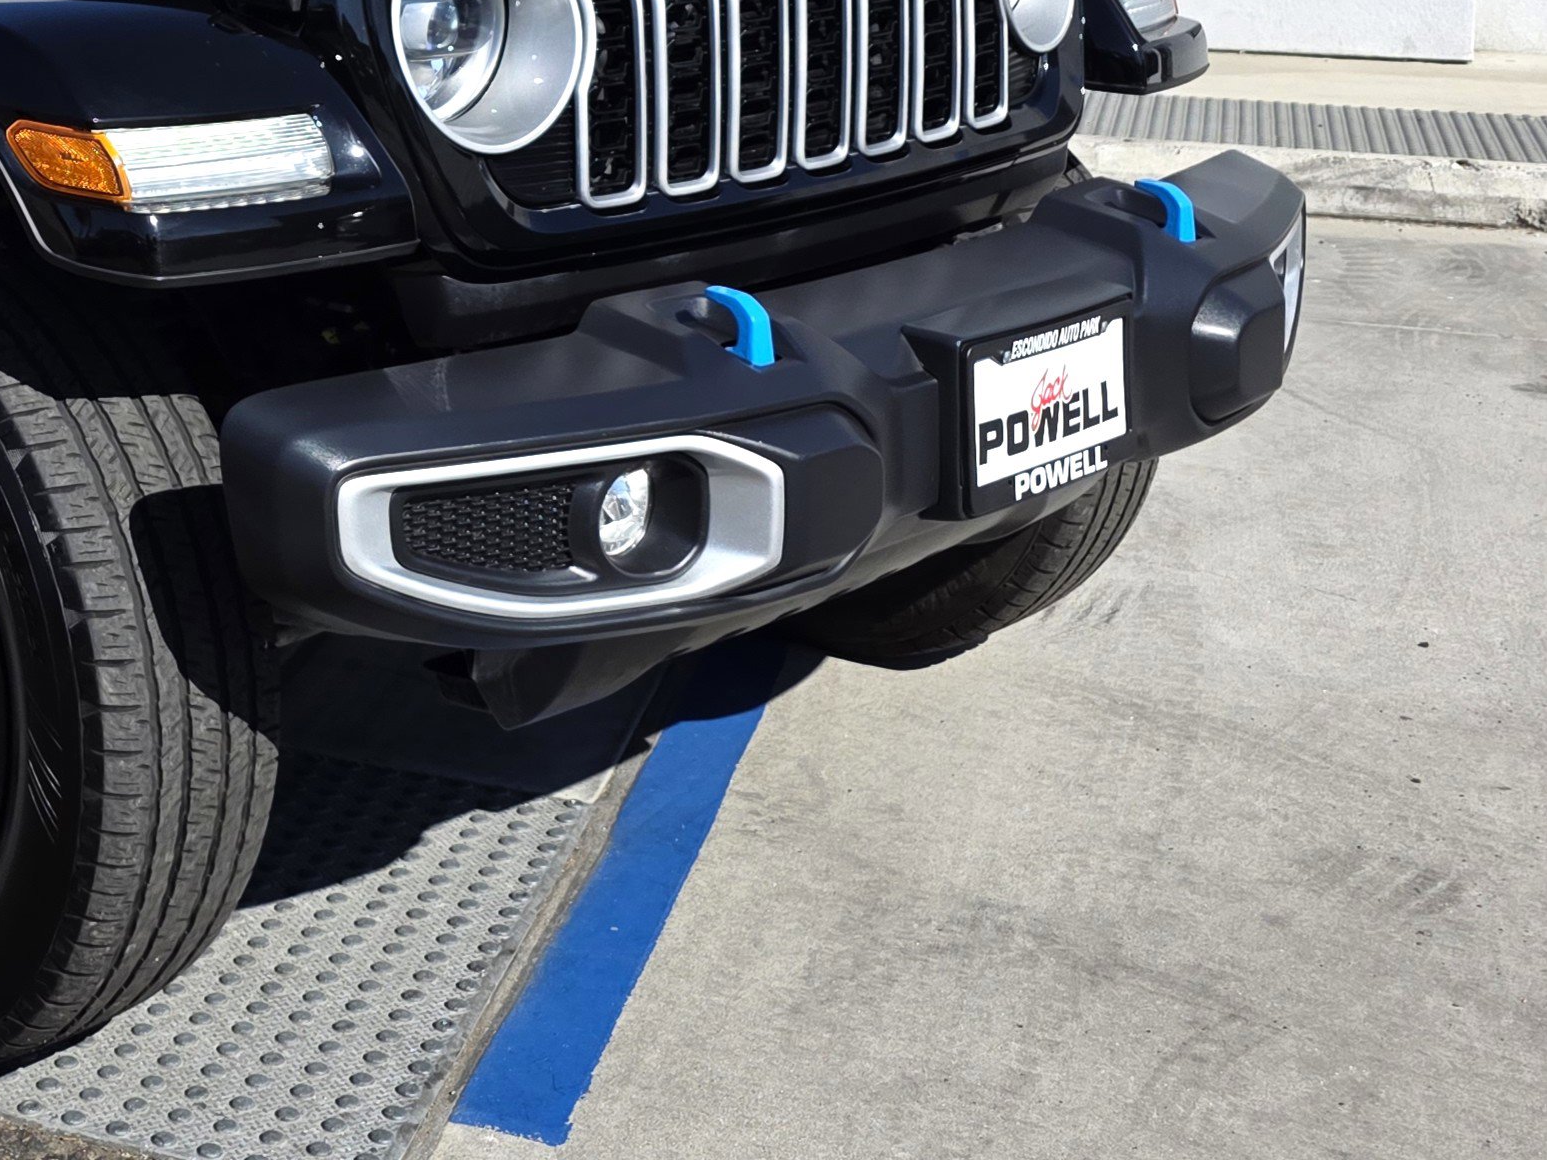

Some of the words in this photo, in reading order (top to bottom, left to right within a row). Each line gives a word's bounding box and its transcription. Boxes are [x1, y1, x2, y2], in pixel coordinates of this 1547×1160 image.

[1011, 329, 1059, 359] ESCONDIDO
[1058, 323, 1081, 347] AUTO
[1080, 316, 1101, 339] PARK
[979, 381, 1119, 466] POWELL
[1030, 364, 1072, 431] Jack
[1015, 445, 1108, 502] POWELL
